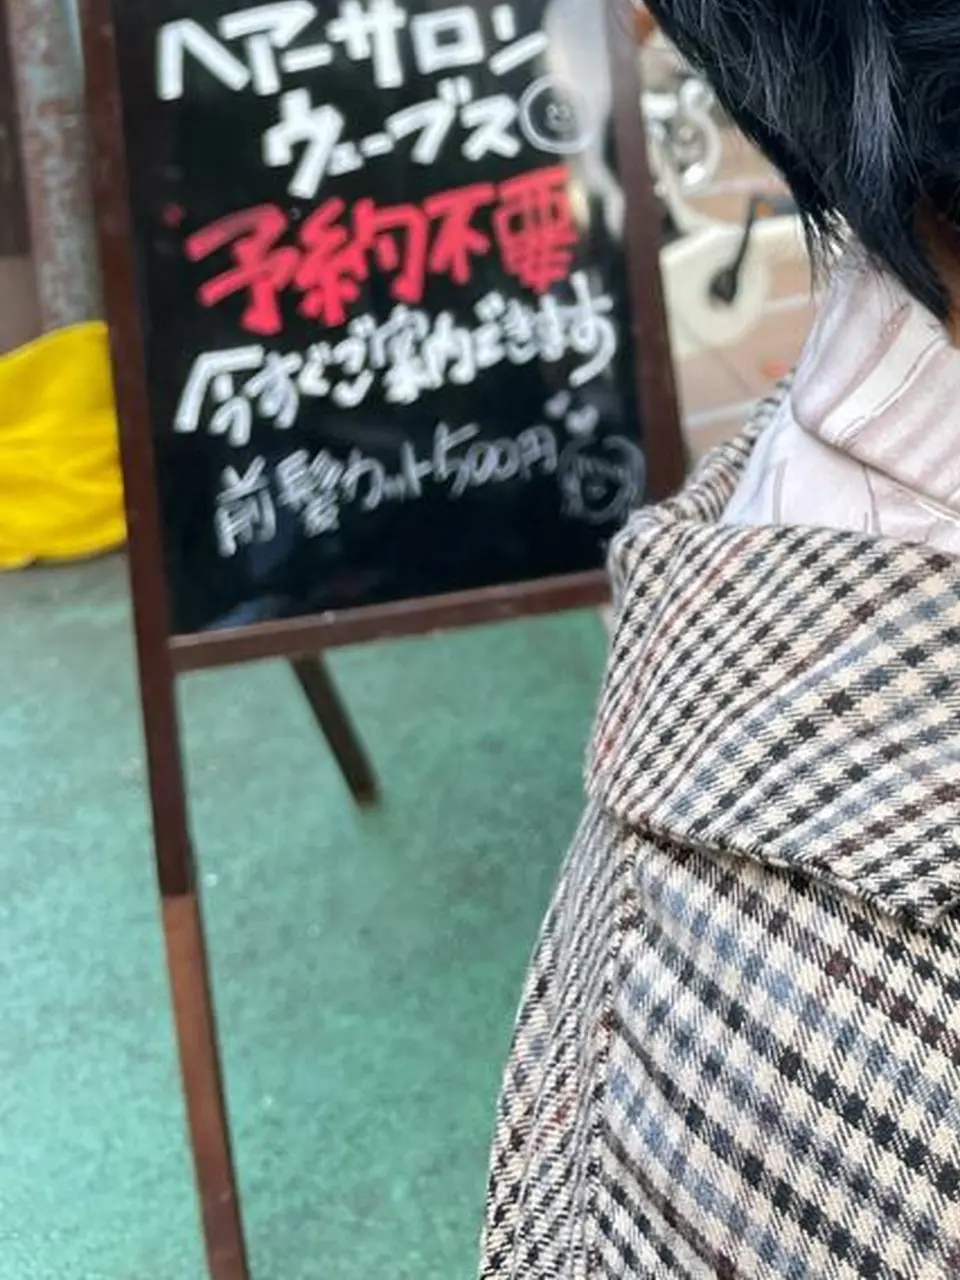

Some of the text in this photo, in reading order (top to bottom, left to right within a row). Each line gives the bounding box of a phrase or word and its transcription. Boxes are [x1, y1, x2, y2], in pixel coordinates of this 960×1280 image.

[186, 165, 577, 334] 予約不要
[173, 270, 617, 447] 今すぐご案内できます
